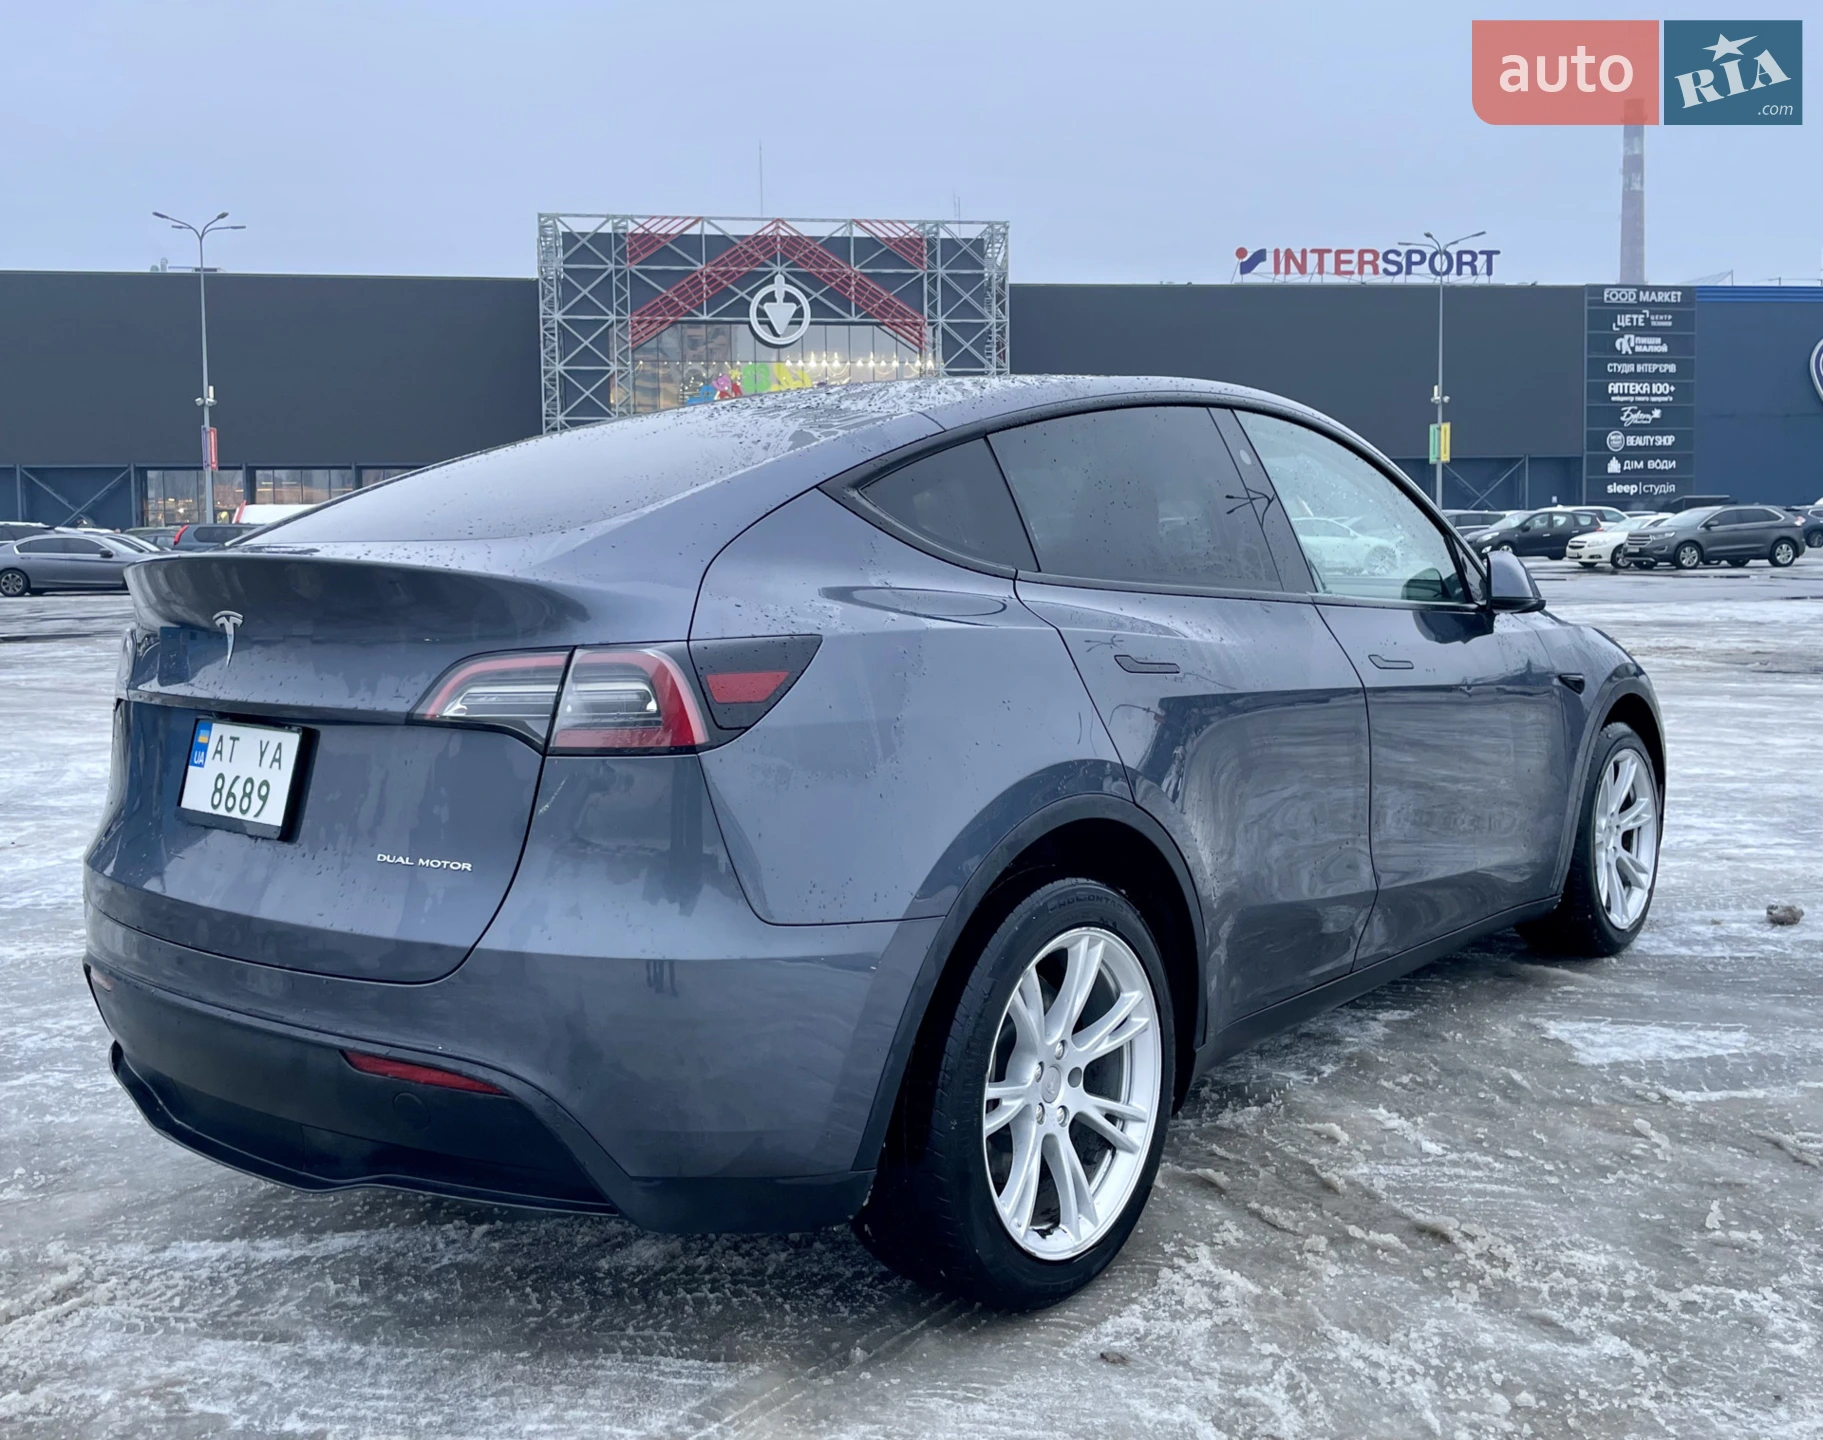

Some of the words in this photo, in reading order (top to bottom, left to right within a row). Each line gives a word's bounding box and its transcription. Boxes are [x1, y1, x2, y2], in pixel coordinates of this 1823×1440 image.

[1273, 247, 1501, 276] INTERSPORT
[1604, 289, 1637, 303] FOOD
[1639, 290, 1682, 303] MARKET
[1616, 314, 1645, 327] ЦЕТЕ
[1634, 343, 1668, 353] МАЛЮЙ
[1607, 363, 1635, 374] СТУДІЯ
[1608, 382, 1651, 394] АПТЕКА
[1652, 383, 1676, 394] 100+
[1626, 435, 1654, 447] BEAUTY
[1654, 434, 1676, 446] SHOP
[1623, 460, 1644, 471] ДІМ
[1647, 459, 1677, 471] ВОДИ
[1607, 482, 1638, 496] sleep
[193, 750, 205, 765] UA
[211, 735, 240, 764] AT
[258, 740, 283, 771] YA
[210, 773, 271, 818] 8689
[376, 853, 414, 866] DUAL
[418, 858, 473, 872] MOTOR
